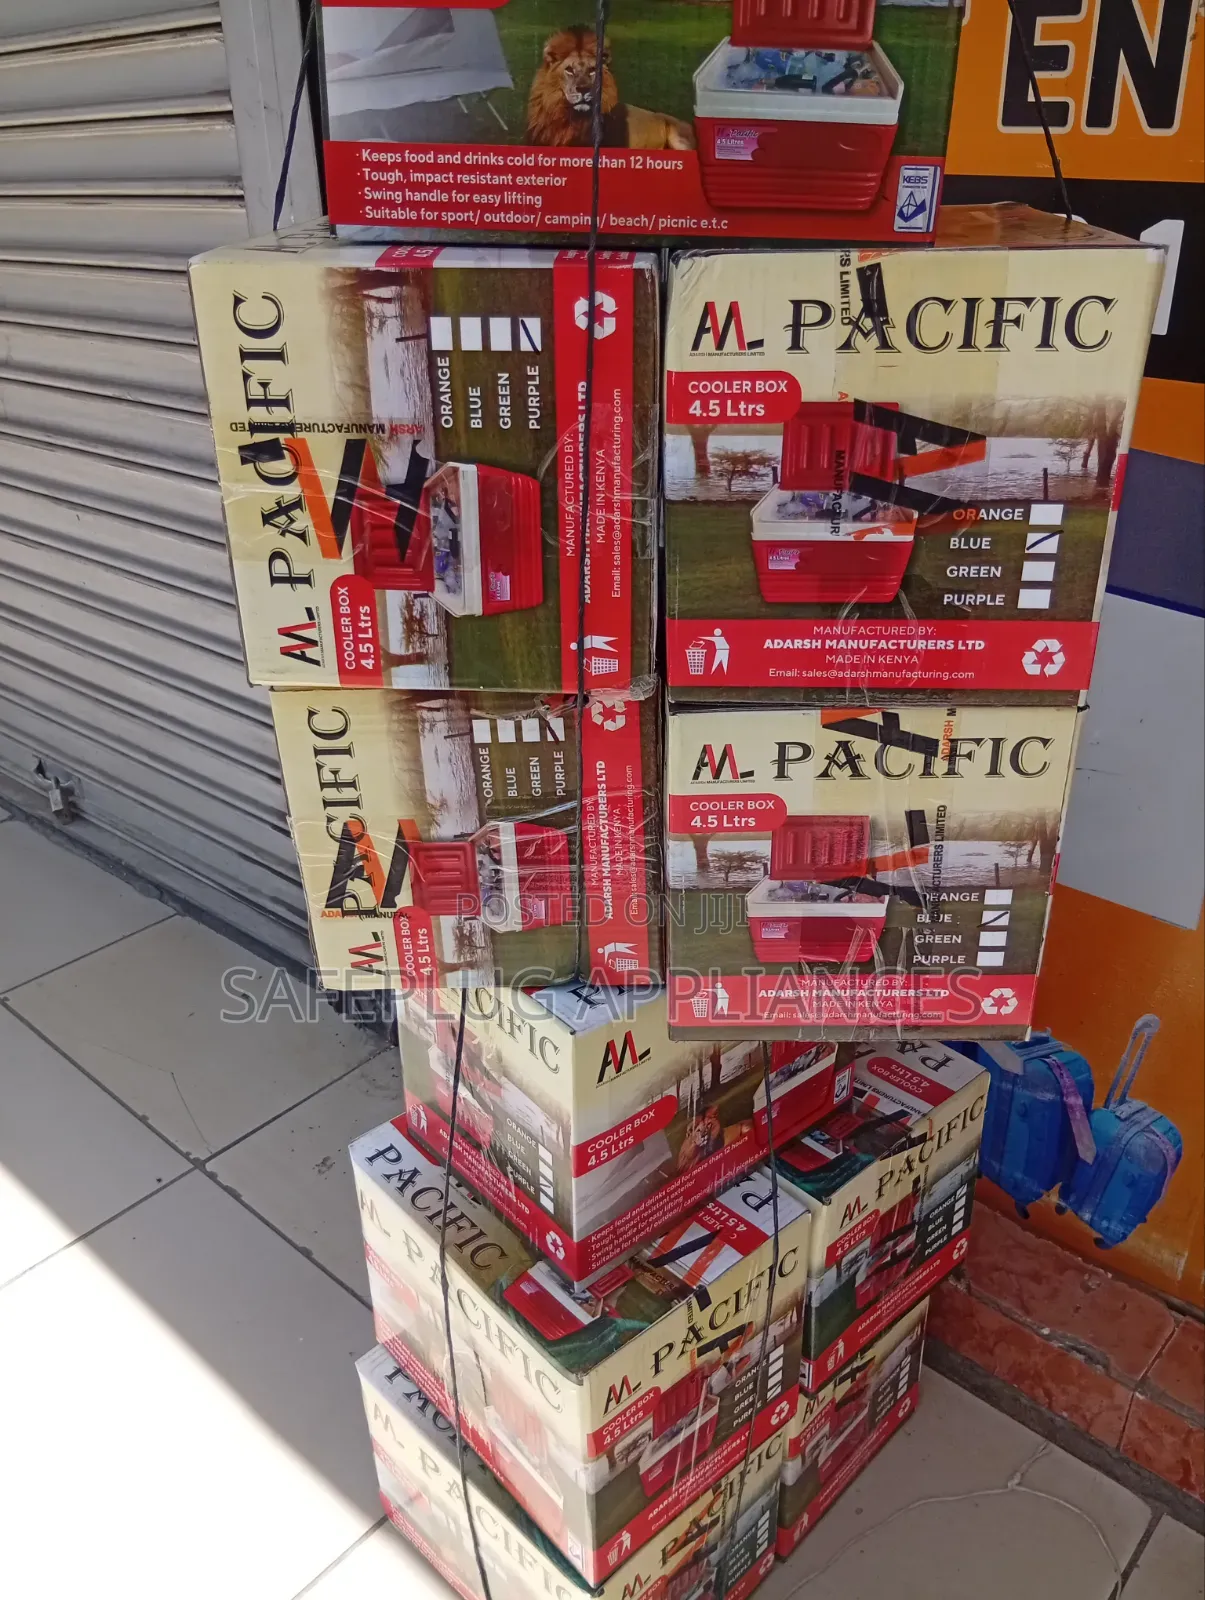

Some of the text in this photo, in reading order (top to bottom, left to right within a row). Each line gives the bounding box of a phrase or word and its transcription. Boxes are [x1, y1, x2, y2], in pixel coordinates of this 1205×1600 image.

[962, 0, 1205, 136] EN
[362, 149, 683, 170] Keeps food and drinks cold for more than 12 hours
[362, 168, 567, 186] Tough, impact resistant exterior
[902, 174, 928, 184] KEBS
[364, 187, 542, 208] Swing handle for easy lifting
[365, 206, 728, 230] Suitable for sport/ outdoor/ beach/ picnic e.t.c
[839, 271, 850, 326] LIMITED
[783, 294, 1118, 354] PACIFIC
[437, 356, 454, 429] ORANGE
[498, 372, 512, 430] GREEN
[527, 365, 540, 430] PURPLE
[688, 380, 788, 394] COOLER BOX
[468, 386, 482, 429] BLUE
[688, 400, 765, 417] 4.5 Ltrs
[232, 289, 315, 592] PACIFIC
[564, 433, 576, 557] MANUFACTURED BY:
[596, 448, 606, 544] MADE IN KENYA
[612, 388, 624, 598] Email: sales@adarshmanufacturing.com
[953, 508, 1024, 520] ORANGE
[950, 538, 992, 549] BLUE
[946, 566, 1002, 578] GREEN
[943, 594, 1006, 606] PURPLE
[338, 586, 356, 670] COOLER BOX
[358, 605, 374, 670] 4.5 Ltrs
[814, 626, 936, 636] MANUFACTURED BY:
[763, 638, 985, 650] ADARSH MANUFACTURERS LTD
[826, 655, 918, 664] MADE IN KENYA
[769, 668, 975, 680] Email: sales@adarshmanufacturing.com
[482, 747, 492, 798] ORANGE
[556, 750, 564, 796] PURPLE
[770, 736, 1055, 782] PACIFIC
[508, 767, 518, 798] BLUE
[531, 756, 542, 797] GREEN
[690, 800, 775, 812] COOLER BOX
[690, 814, 756, 828] 4.5 Ltrs
[613, 808, 622, 838] KENYA
[934, 804, 947, 842] LIMITED
[588, 813, 599, 886] MANUFACTURED
[596, 760, 614, 920] ADARSH MANUFACTURERS LTD
[400, 916, 416, 976] COOLER BOX
[416, 928, 432, 976] 4.5 Ltrs
[914, 934, 962, 944] GREEN
[912, 955, 966, 964] PURPLE
[758, 989, 808, 998] ADARSH
[812, 989, 923, 998] MANUFACTURERS
[802, 979, 890, 987] MANUFACTURED
[813, 1000, 893, 1008] MADE KENYA
[872, 1064, 922, 1093] COOLER BOX
[890, 1064, 911, 1078] Ltrs
[506, 1118, 538, 1149] ORANGE
[507, 1134, 526, 1154] BLUE
[587, 1108, 656, 1154] COOLER BOX
[508, 1150, 532, 1176] GREEN
[587, 1134, 634, 1167] 4.5 Ltrs
[876, 1094, 985, 1201] PACIFIC
[592, 1136, 748, 1243] Keeps food and drinks cold more than hours
[365, 1142, 508, 1271] PACIFIC
[517, 1200, 530, 1215] LTD
[592, 1178, 696, 1251] Tough, impact resistant exterior
[706, 1202, 748, 1232] 4.5 Ltrs
[592, 1196, 684, 1261] Swing handle easy lifting
[926, 1224, 947, 1244] GREEN
[592, 1247, 620, 1270] Suitable
[650, 1246, 800, 1380] PACIFIC
[734, 1382, 754, 1402] BLUE
[602, 1390, 654, 1435] COOLER BOX
[604, 1410, 644, 1446] 4.5 Ltrs
